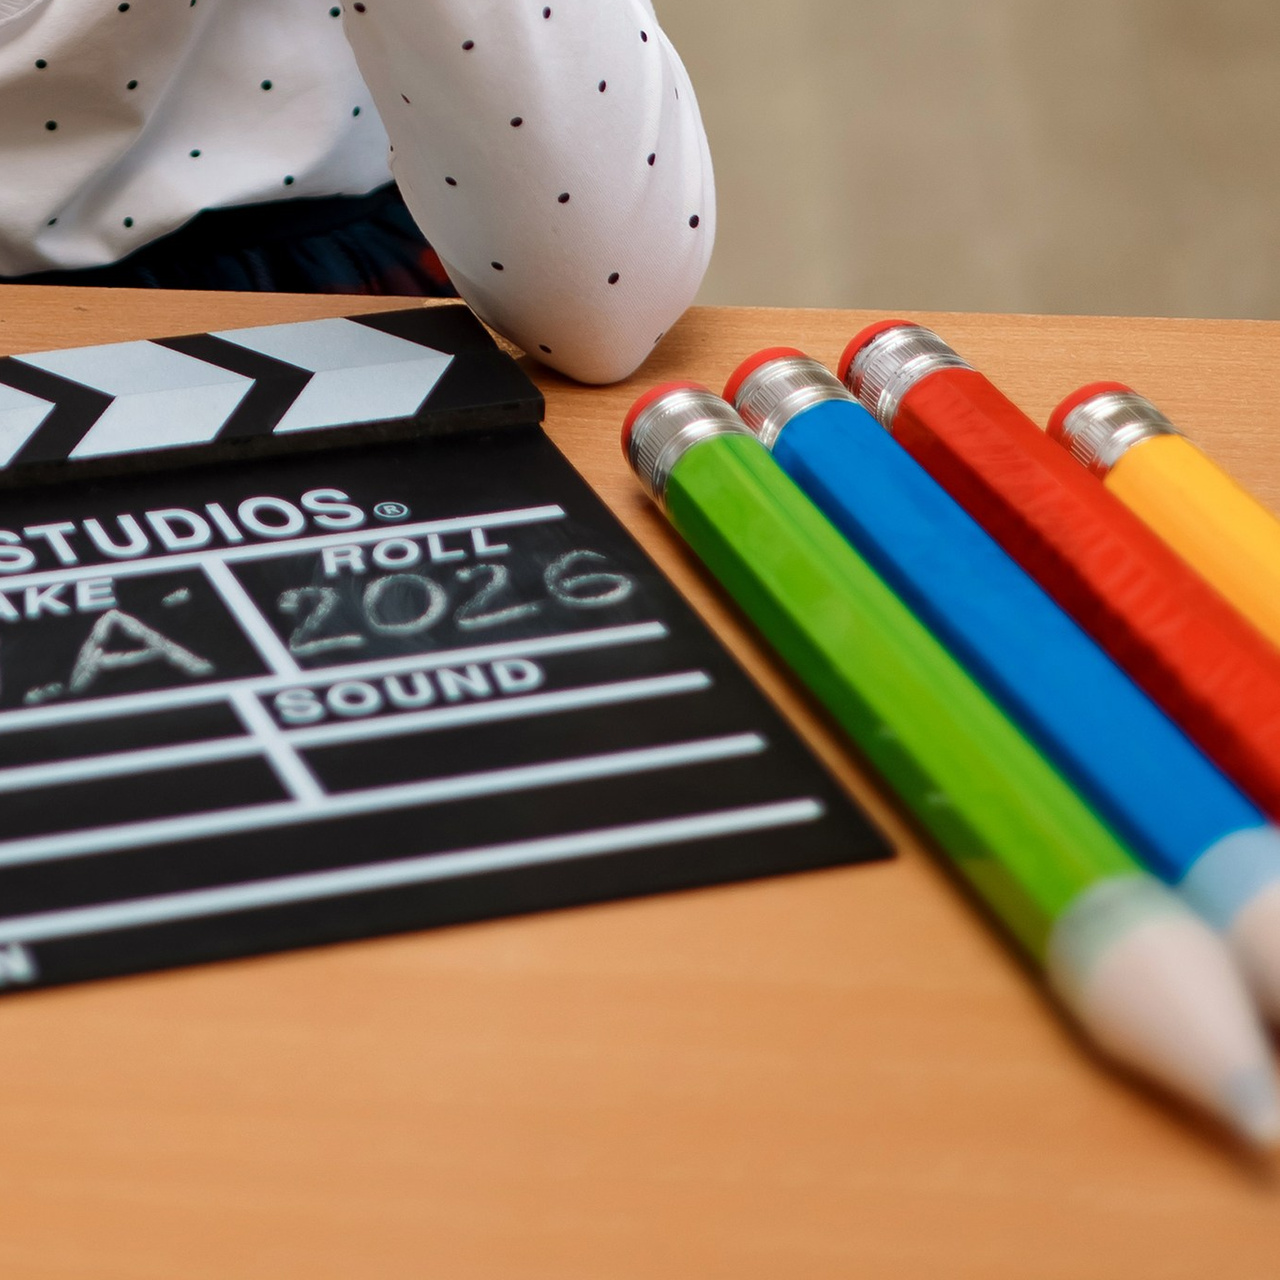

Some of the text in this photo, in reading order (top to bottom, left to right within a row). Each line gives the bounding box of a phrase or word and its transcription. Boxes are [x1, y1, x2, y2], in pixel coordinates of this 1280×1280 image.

[322, 527, 510, 578] ROLL
[278, 549, 633, 656] 2026
[274, 658, 543, 723] SOUND
